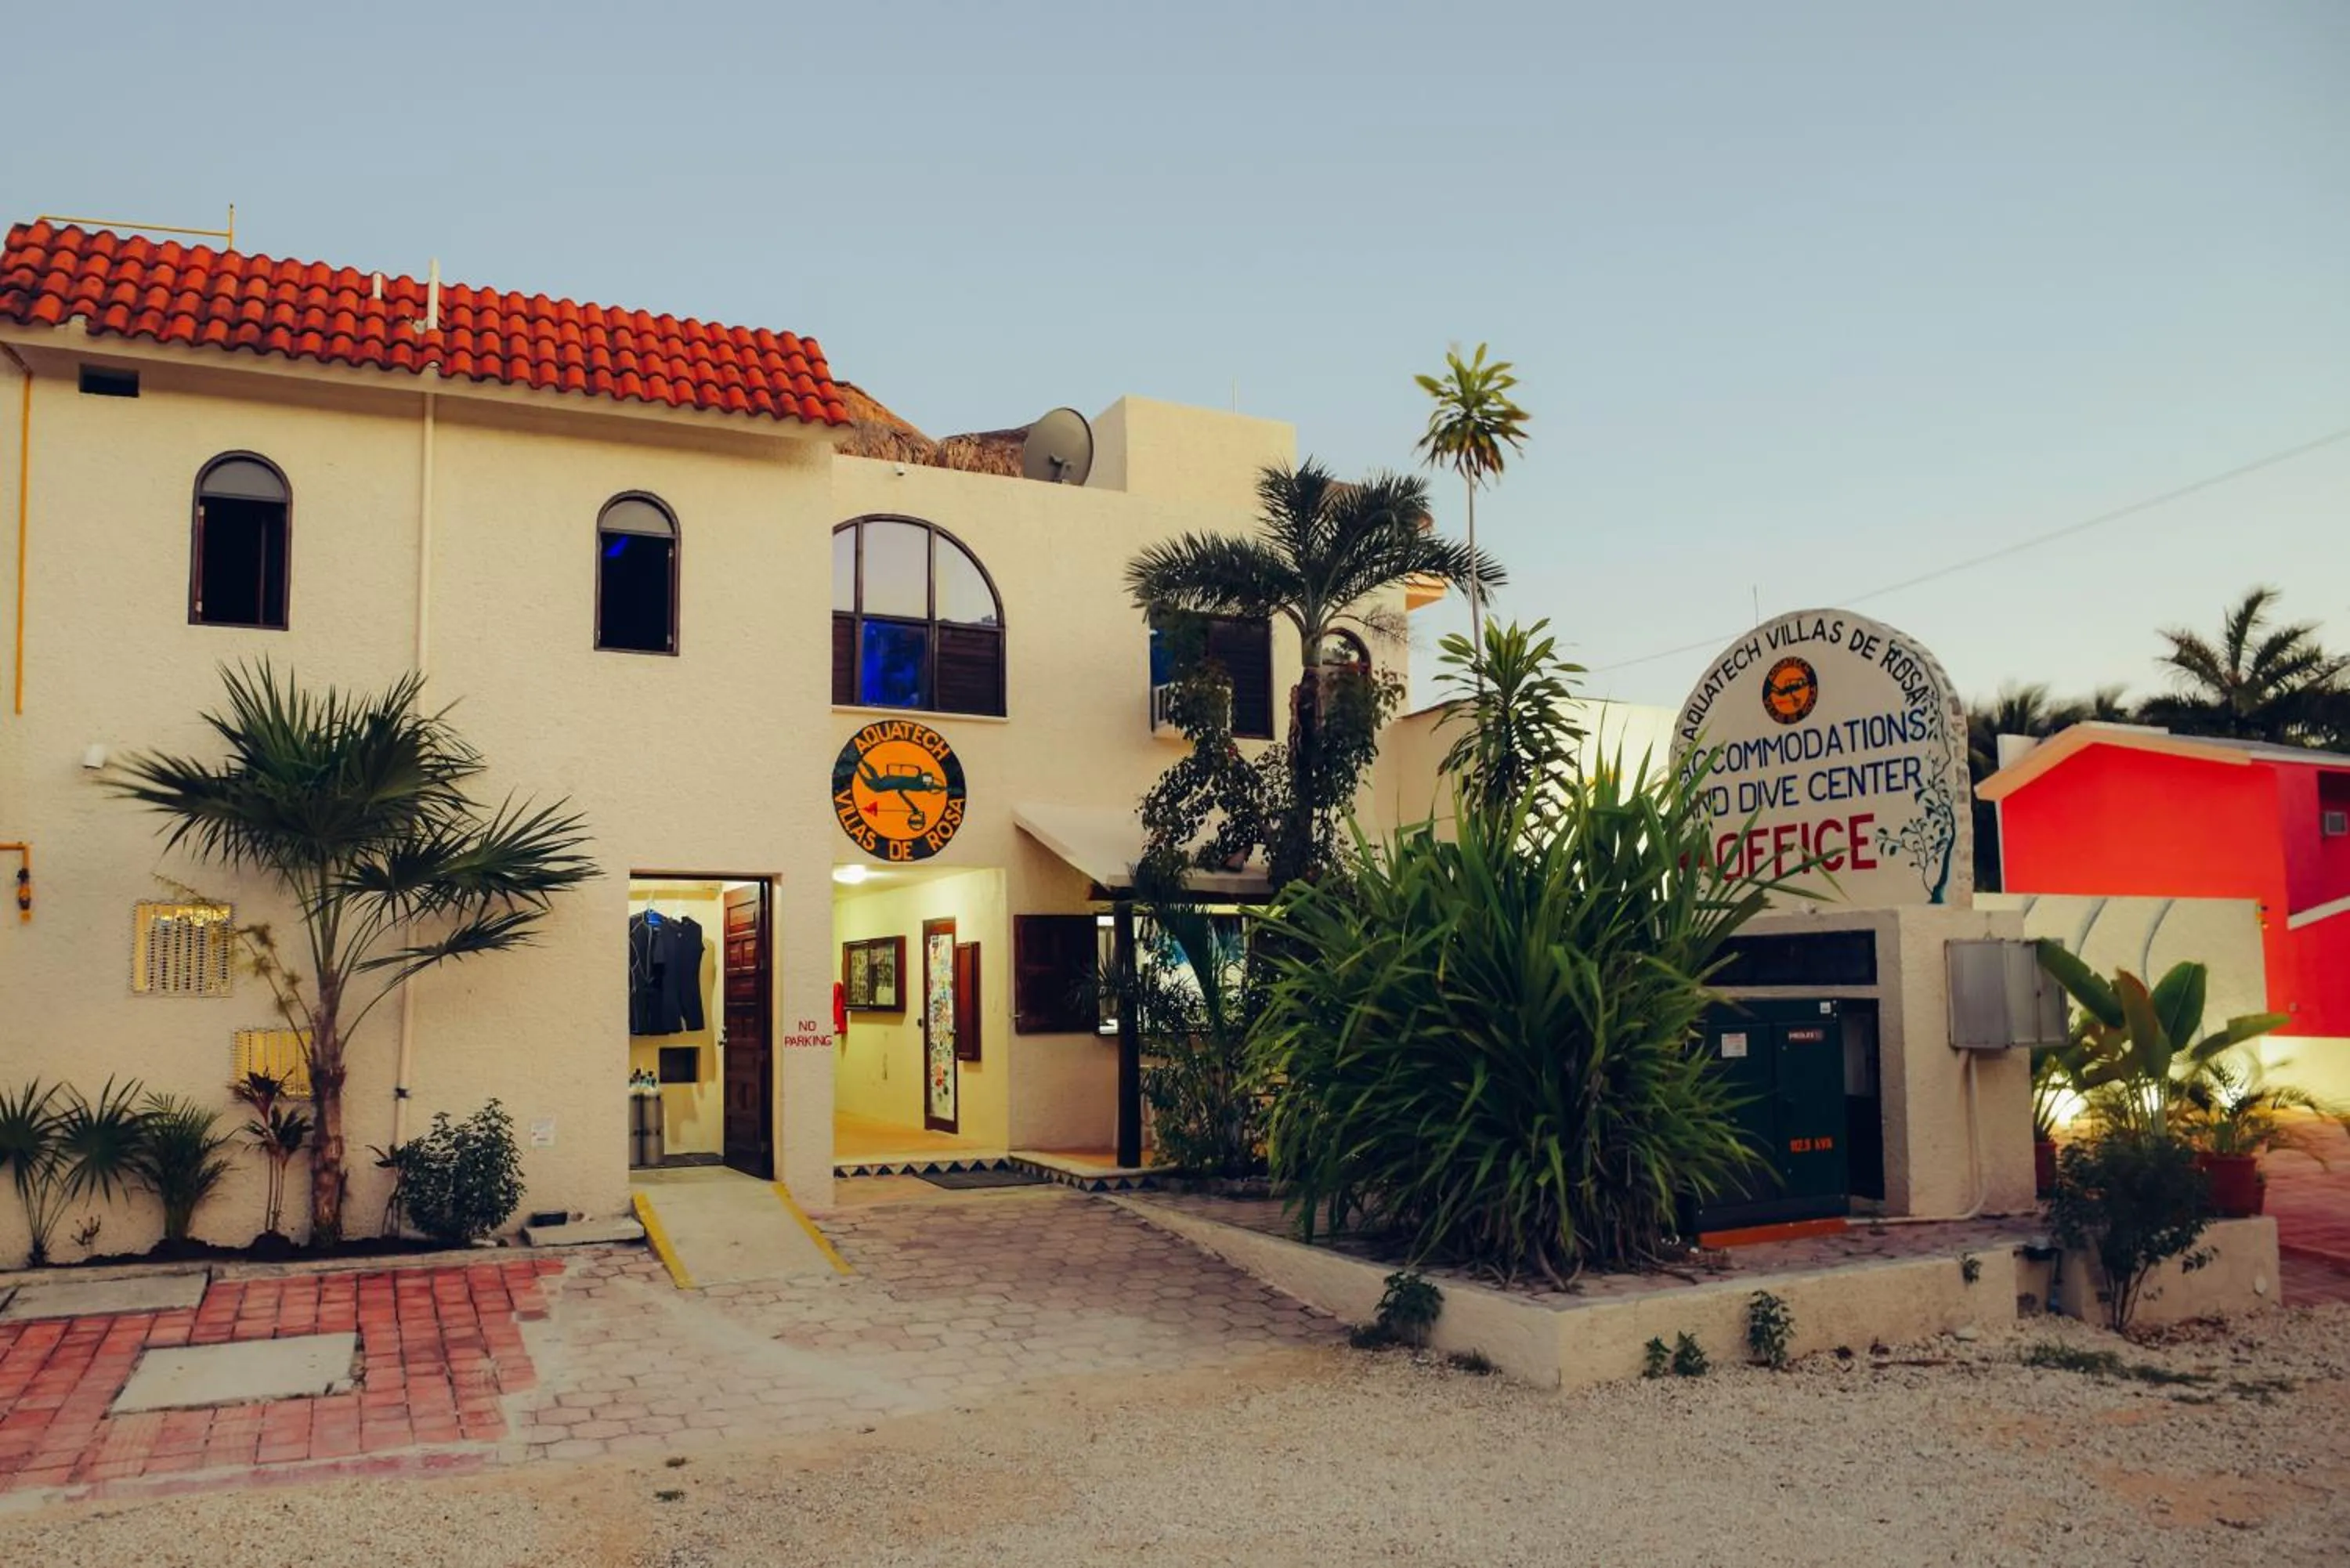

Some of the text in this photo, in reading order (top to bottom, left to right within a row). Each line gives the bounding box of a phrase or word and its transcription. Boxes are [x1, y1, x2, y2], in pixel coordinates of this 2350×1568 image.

[1681, 638, 1762, 742] AQUATECH
[1766, 618, 1845, 651] VILLAS
[1849, 628, 1880, 659] DE
[1880, 647, 1929, 706] ROSA
[854, 722, 950, 760] AQUATECH
[1739, 775, 1801, 814] DIVE
[1808, 757, 1924, 802] CENTER
[835, 789, 964, 860] VILLAS DE ROSA
[1716, 813, 1878, 883] OFFICE
[784, 1035, 833, 1047] PARKING
[798, 1021, 817, 1031] NO
